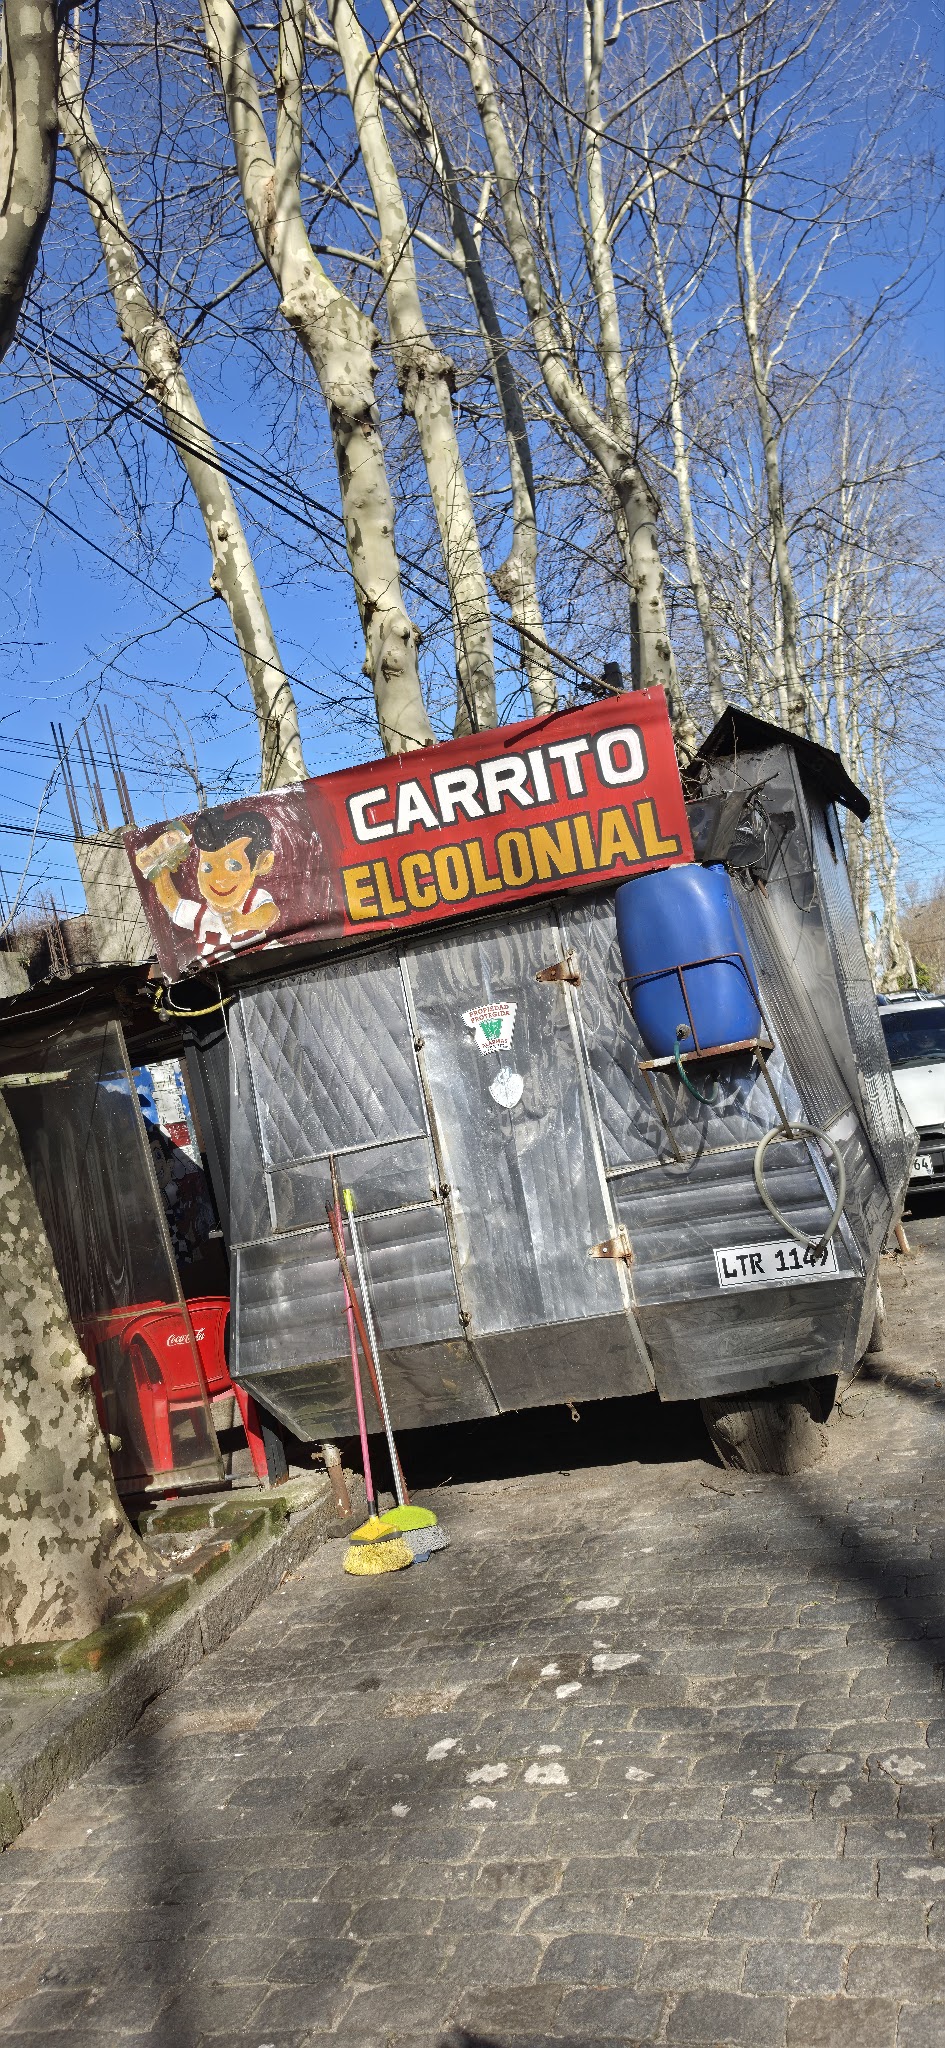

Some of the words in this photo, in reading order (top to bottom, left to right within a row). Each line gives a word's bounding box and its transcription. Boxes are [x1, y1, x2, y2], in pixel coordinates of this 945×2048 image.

[348, 726, 646, 842] CARRITO
[469, 1004, 509, 1017] PROPIEDAD
[470, 1011, 510, 1023] PROTEGIDA
[722, 1253, 765, 1278] LTR
[167, 1327, 206, 1346] Coca-Cla
